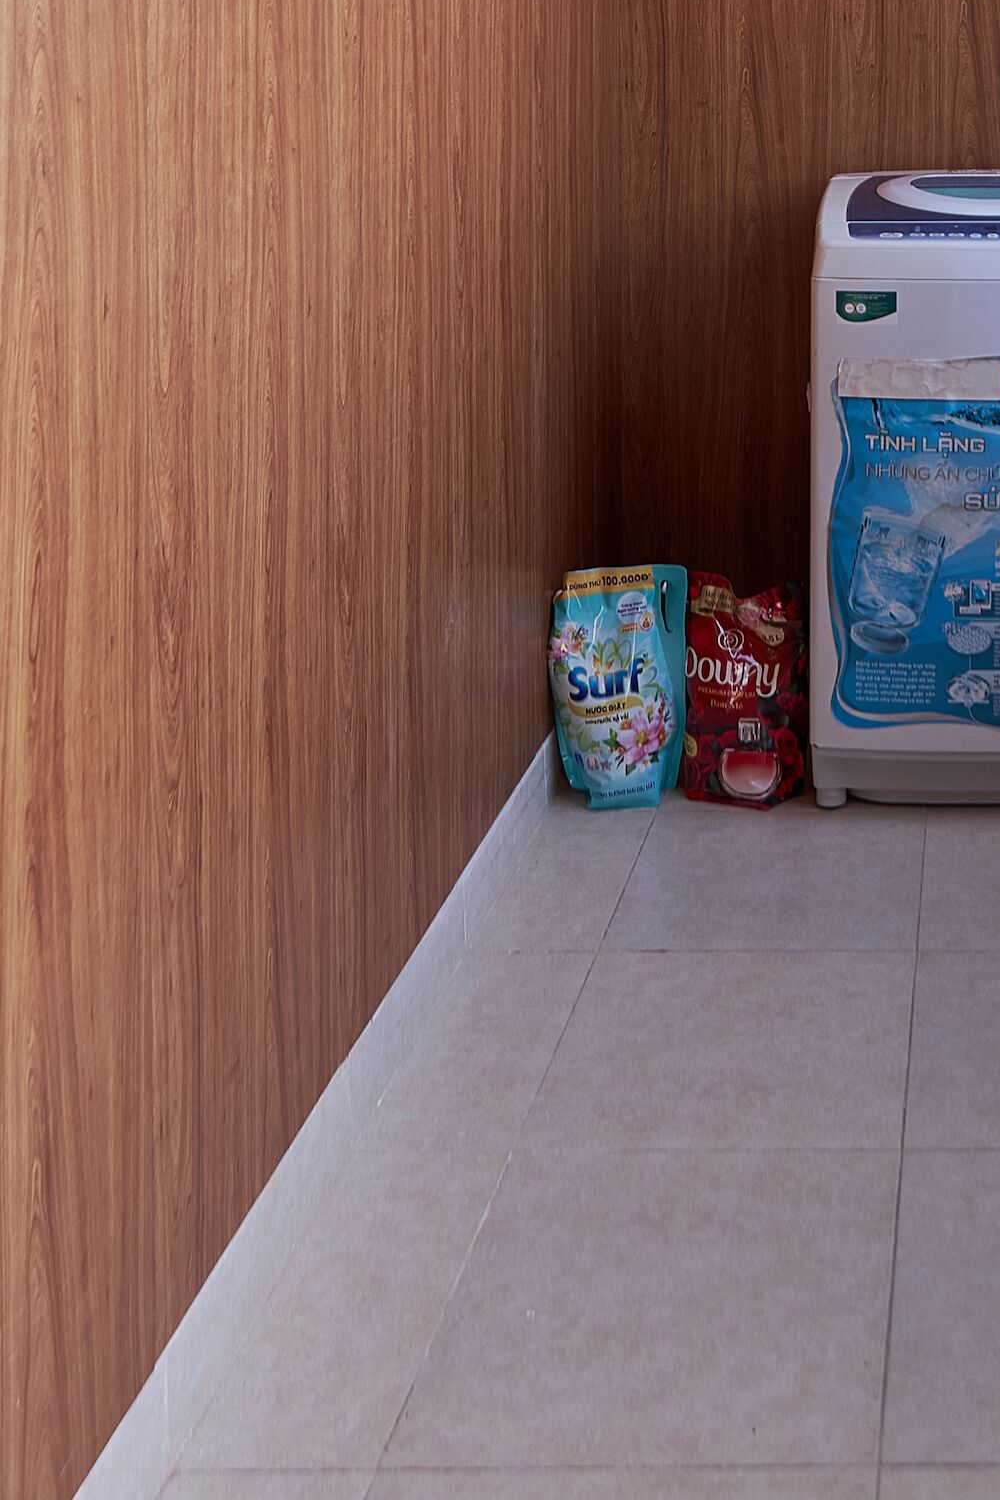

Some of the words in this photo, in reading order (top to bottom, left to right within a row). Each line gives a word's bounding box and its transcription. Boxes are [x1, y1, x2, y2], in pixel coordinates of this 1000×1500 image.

[864, 429, 916, 452] TĨNH
[921, 431, 986, 459] LẶNG
[567, 657, 646, 702] Surf
[685, 646, 781, 698] Downy
